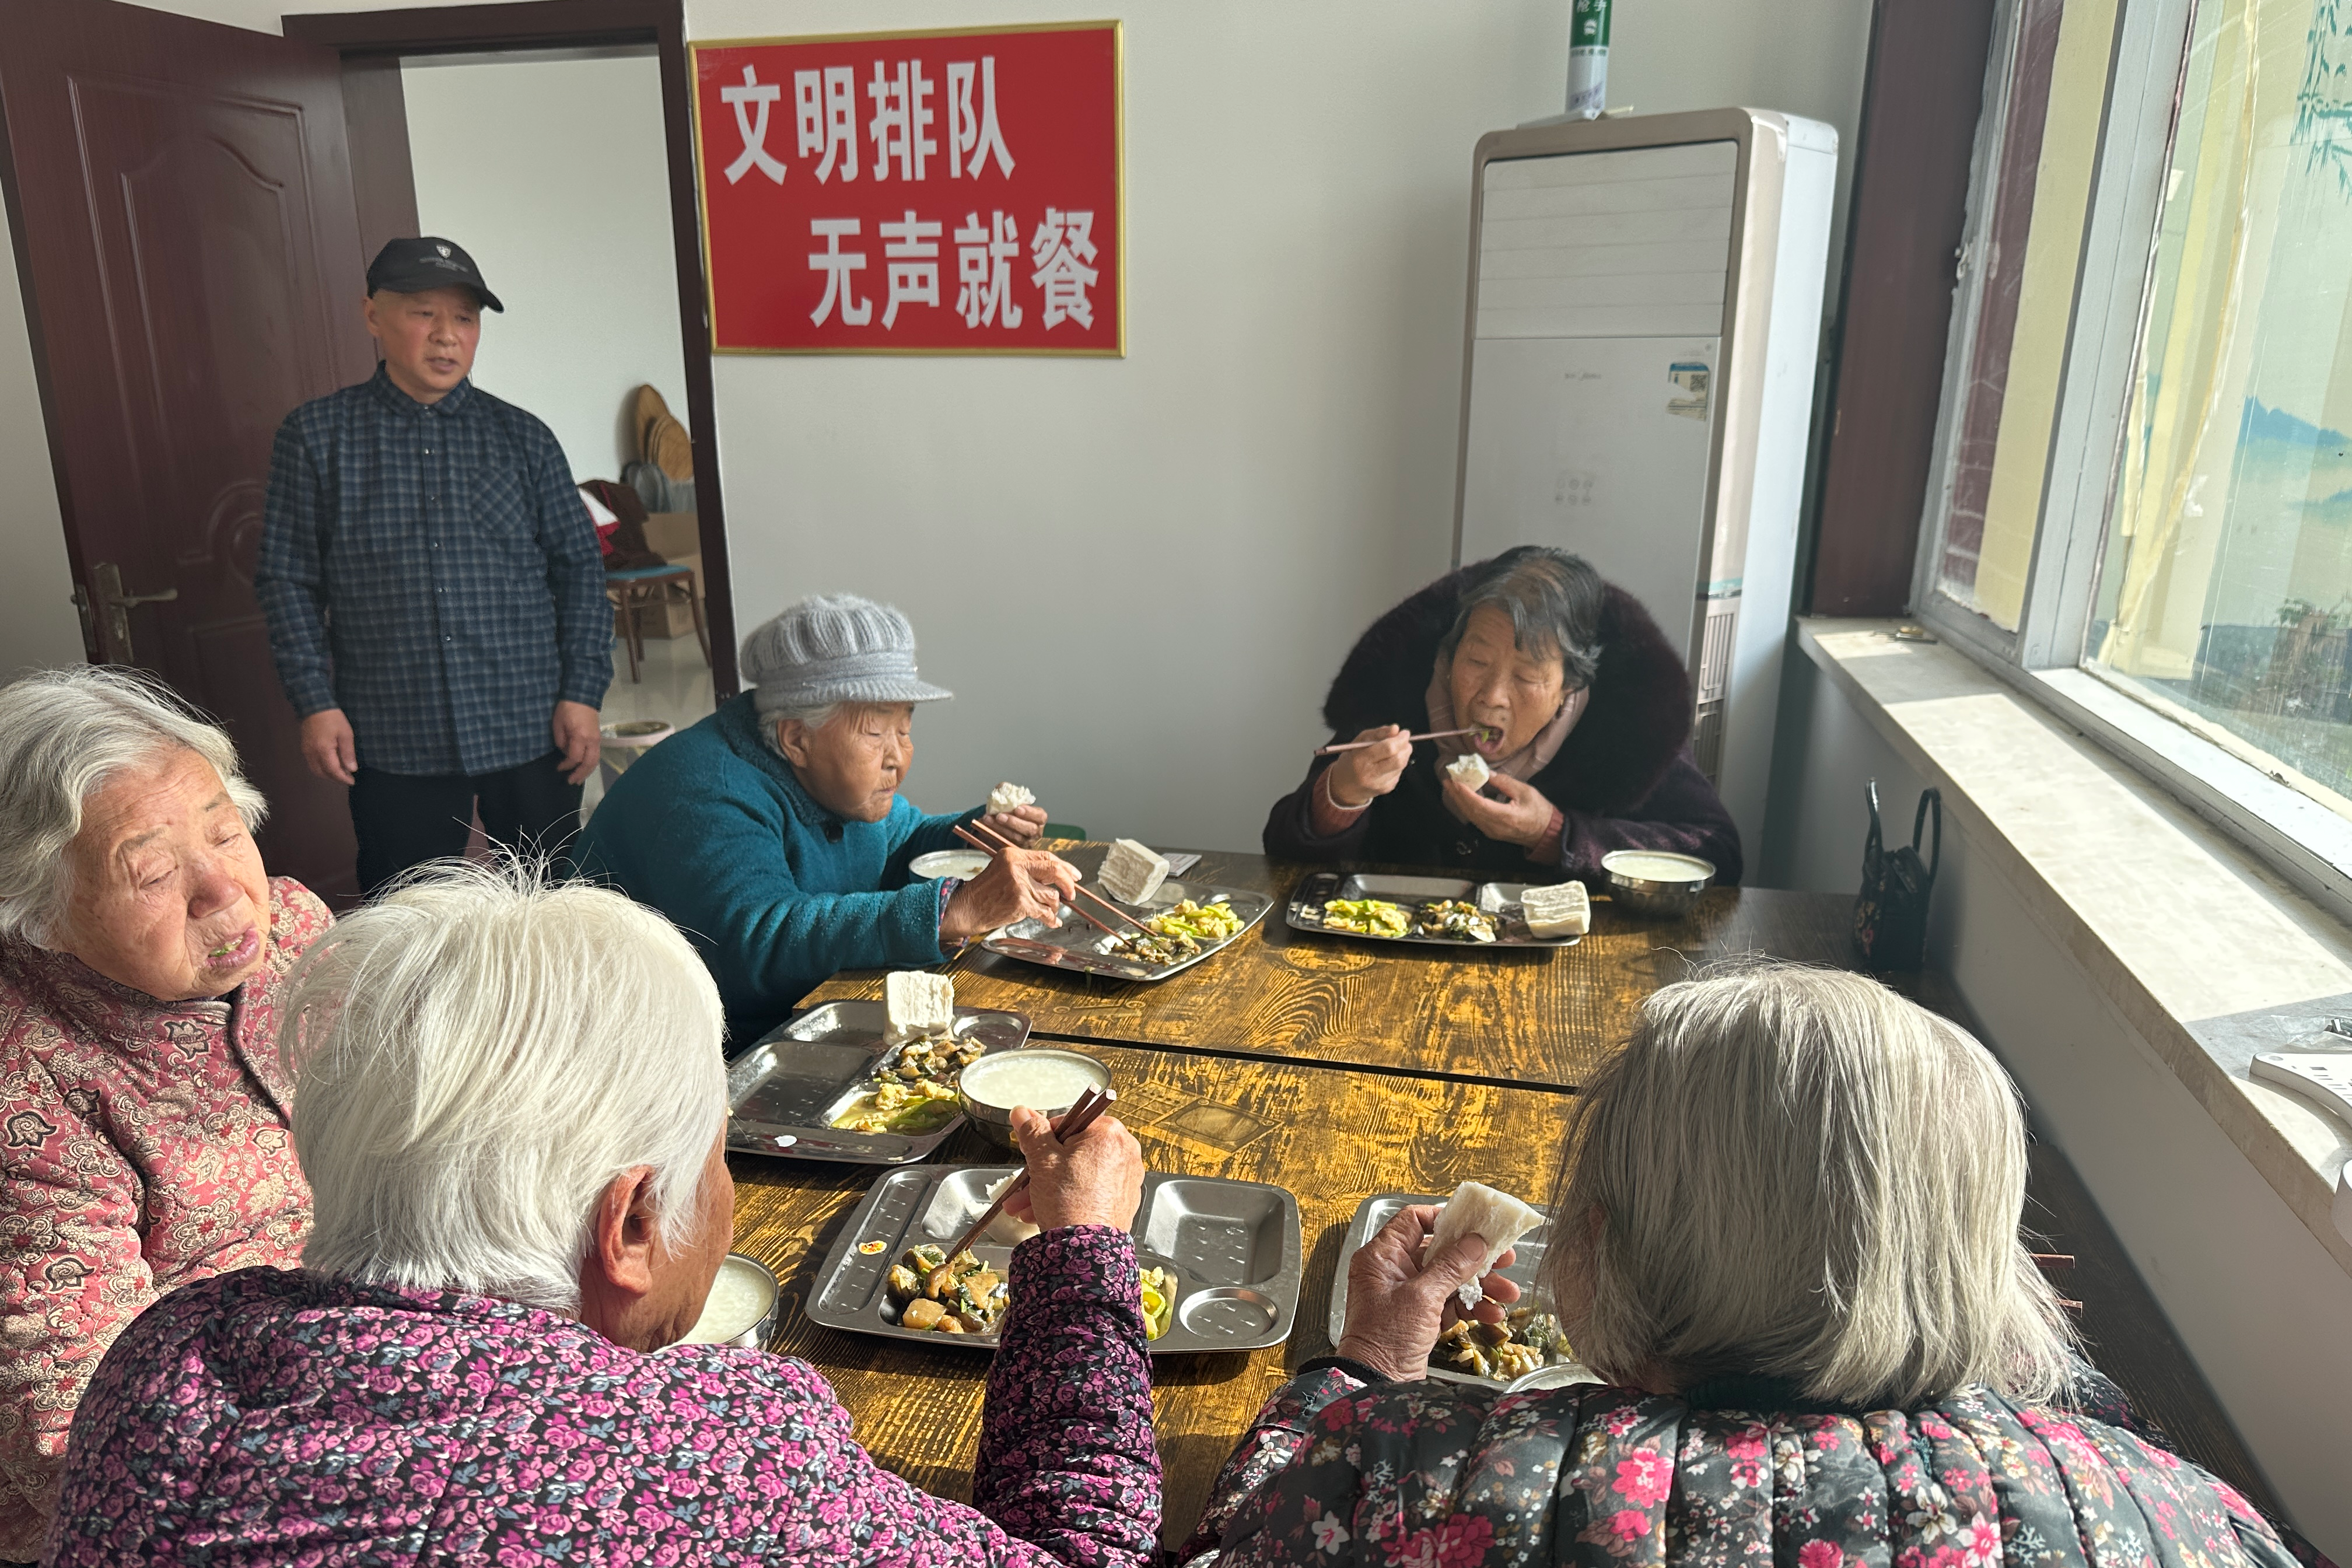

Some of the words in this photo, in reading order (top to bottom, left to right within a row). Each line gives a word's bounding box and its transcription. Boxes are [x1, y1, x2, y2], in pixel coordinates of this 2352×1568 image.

[720, 56, 1016, 186] 文明排队
[807, 206, 1100, 331] 无声就餐
